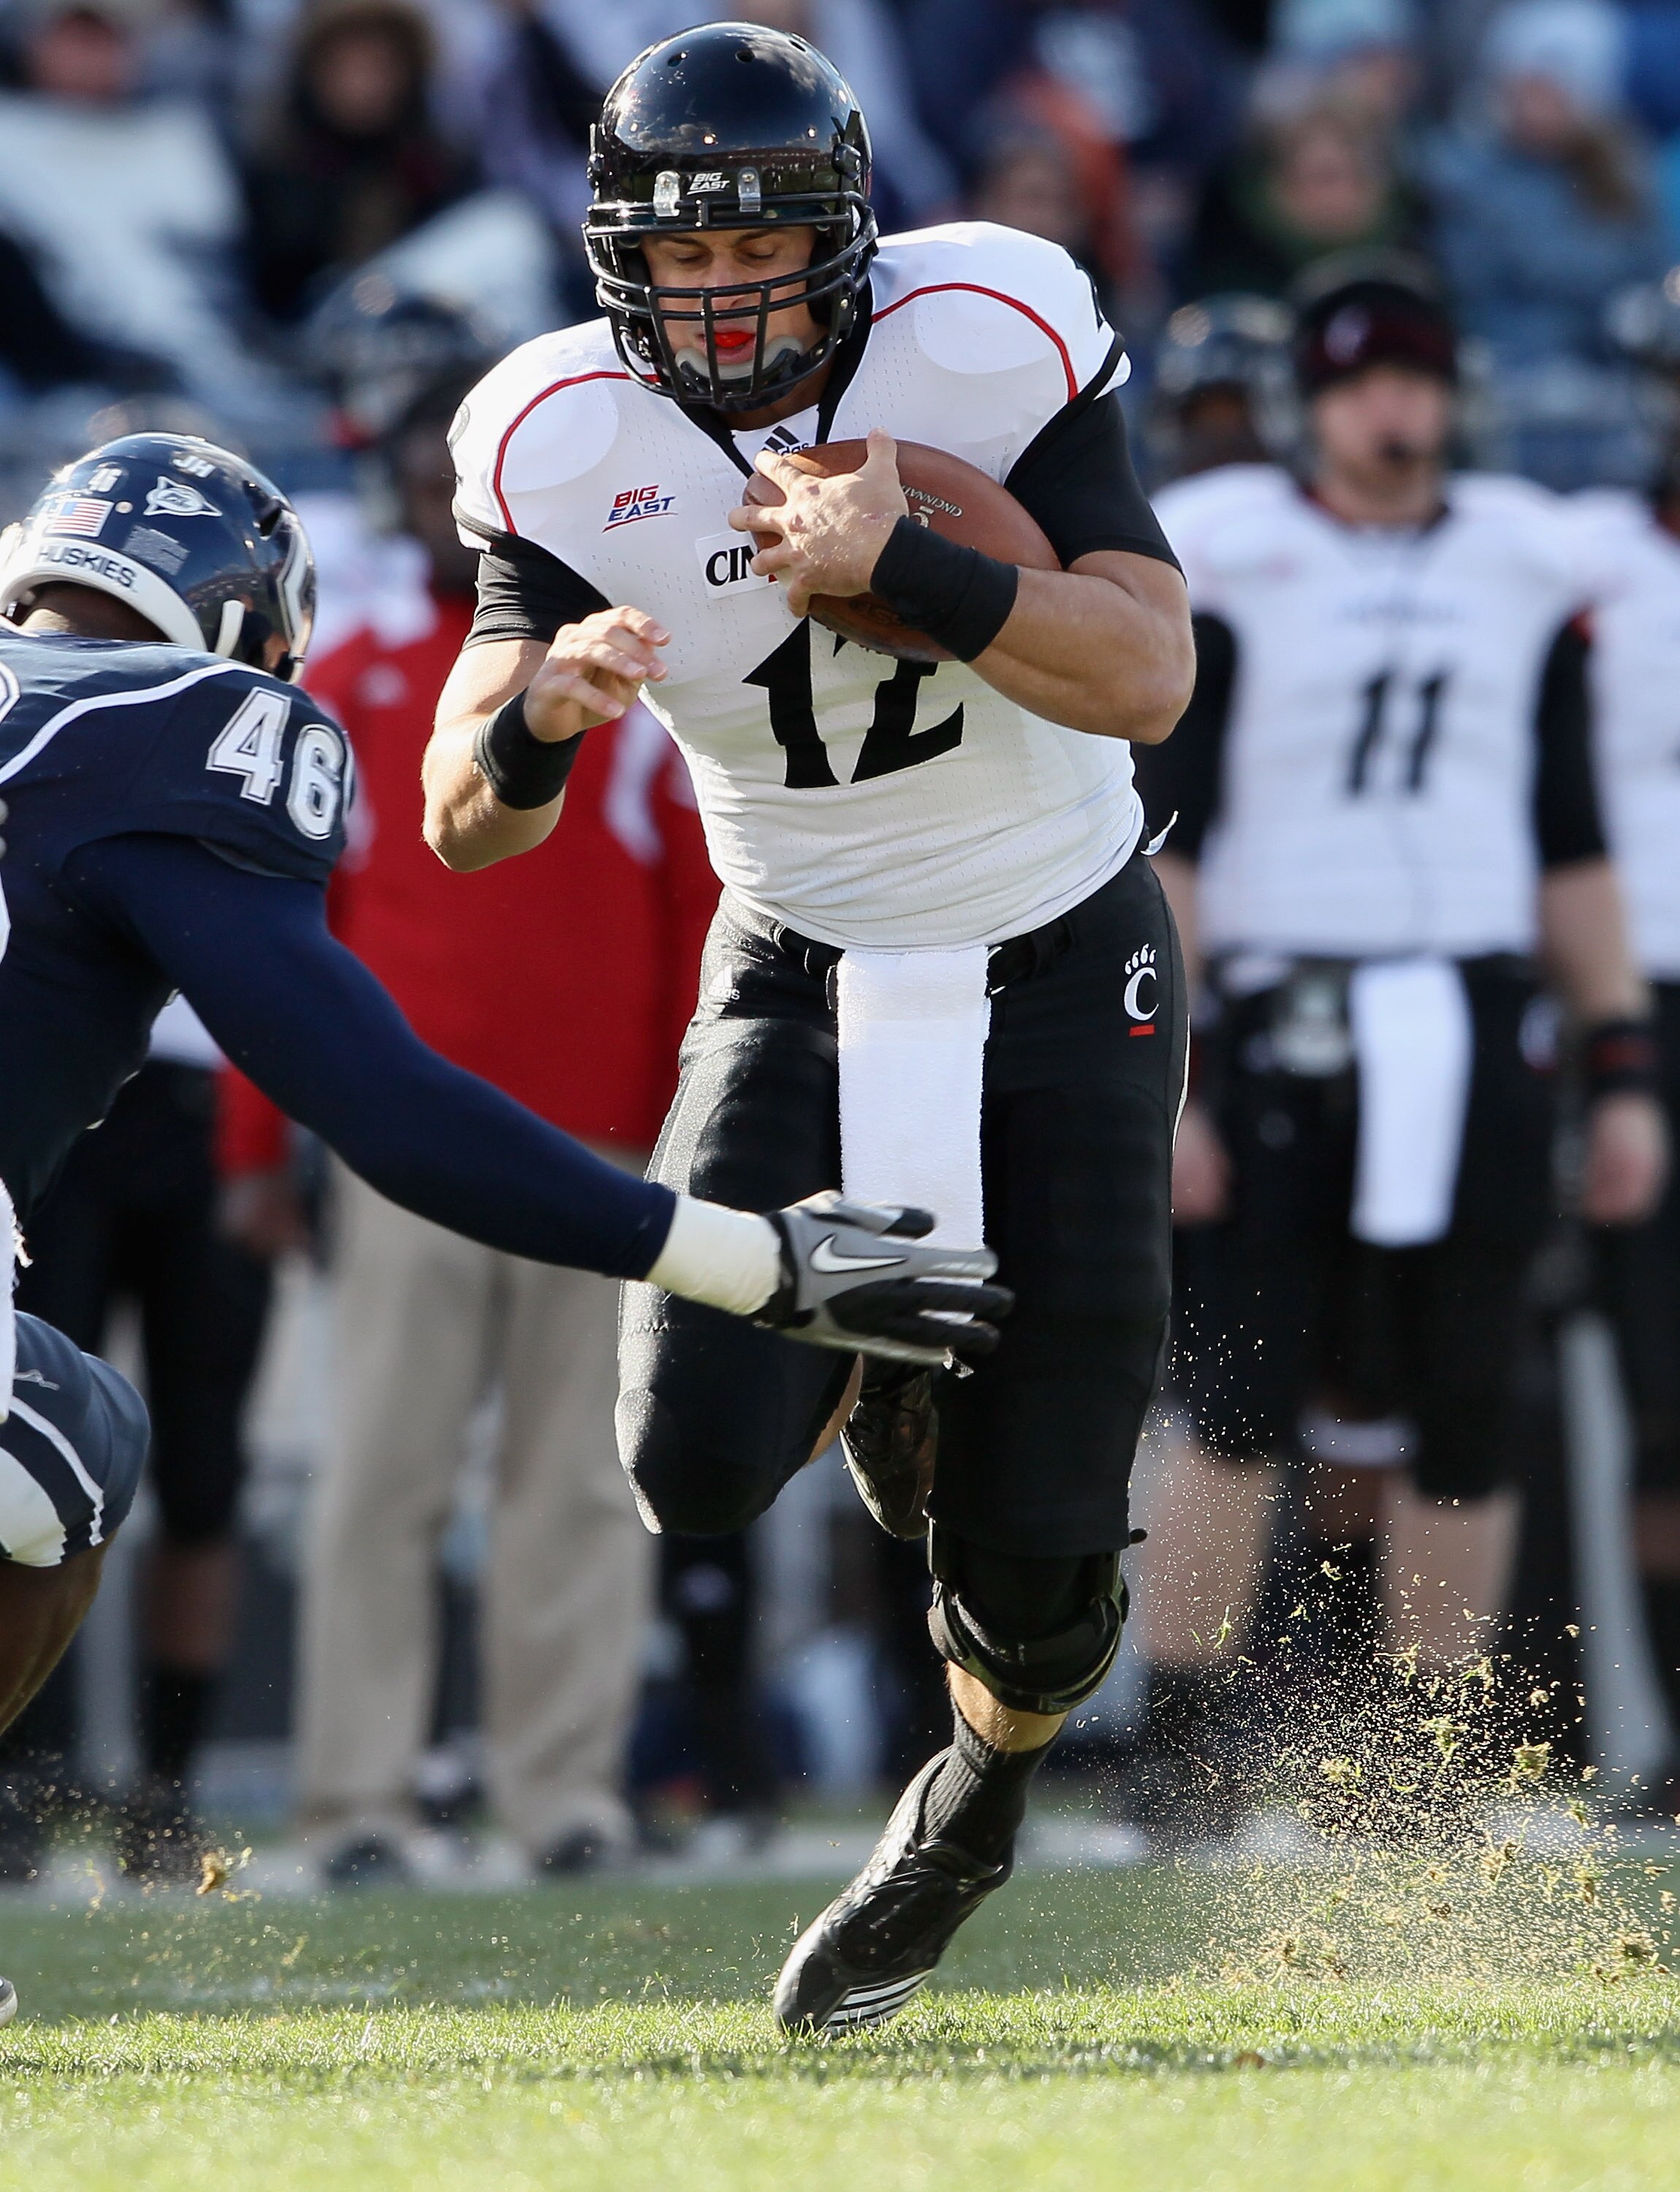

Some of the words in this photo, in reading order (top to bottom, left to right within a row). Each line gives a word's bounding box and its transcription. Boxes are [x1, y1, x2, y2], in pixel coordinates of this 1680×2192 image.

[689, 180, 731, 191] EAST
[693, 172, 723, 183] BIG
[172, 454, 217, 479] JH
[607, 495, 677, 522] EAST
[613, 484, 660, 509] BIG
[38, 544, 137, 588] HUSKIES
[741, 612, 965, 789] 12
[1343, 665, 1451, 799] 11
[205, 685, 347, 841] 46
